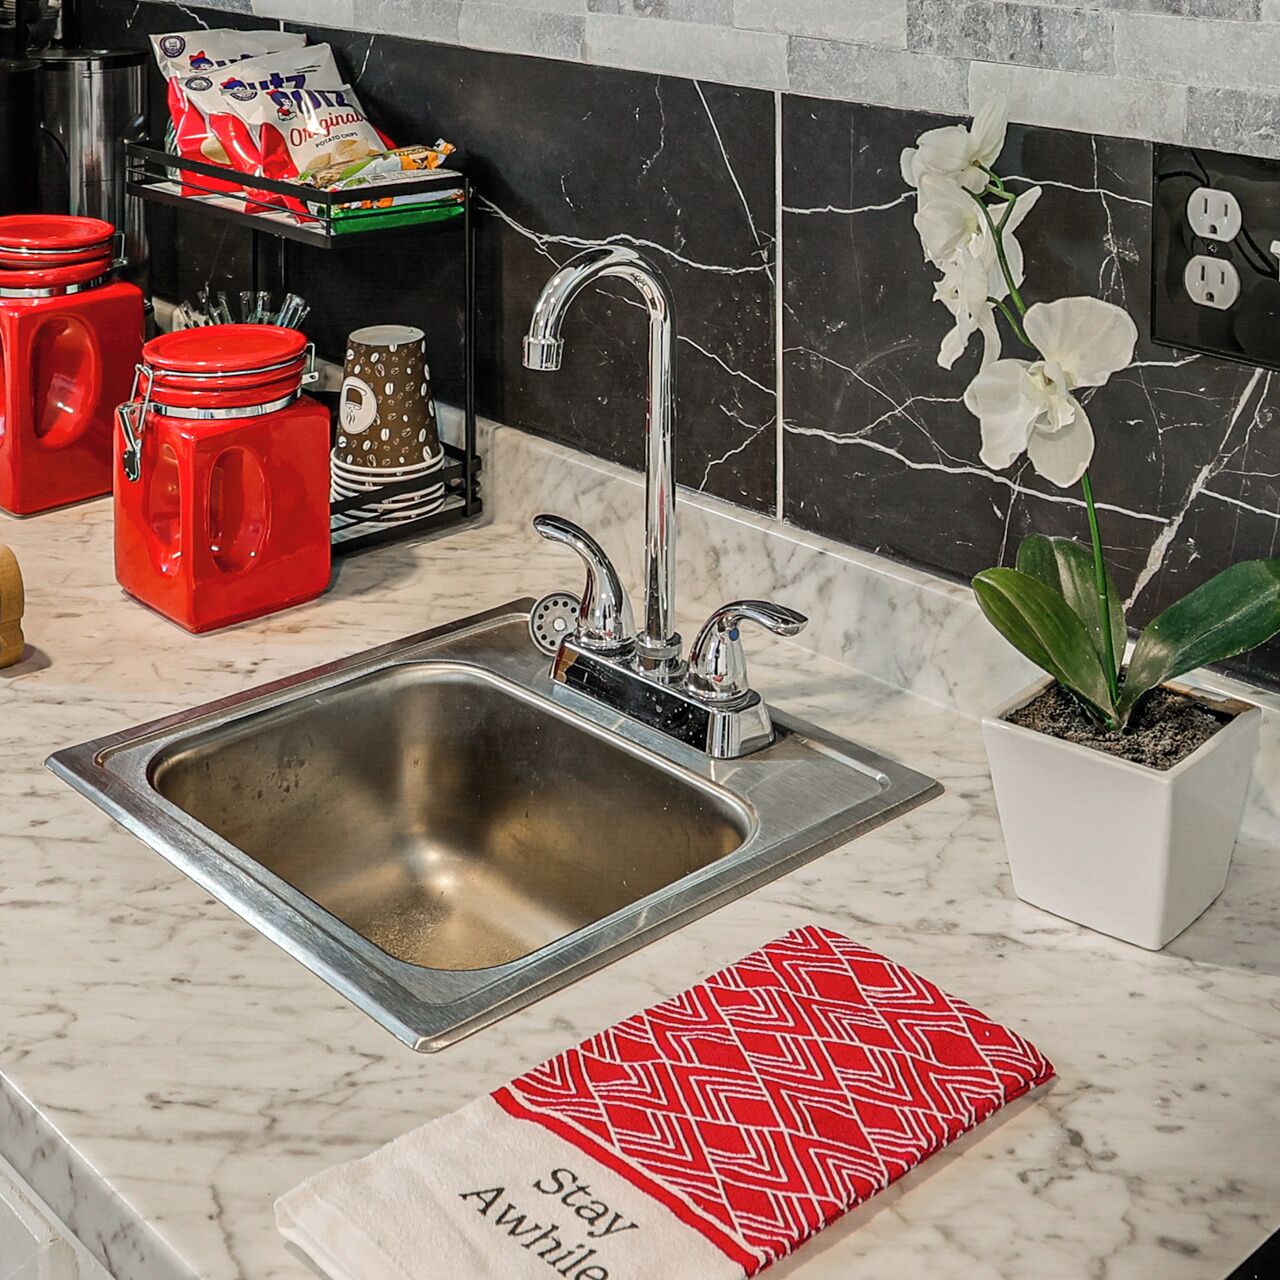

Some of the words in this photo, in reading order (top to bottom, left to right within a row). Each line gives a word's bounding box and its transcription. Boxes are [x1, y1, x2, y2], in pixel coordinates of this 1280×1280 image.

[290, 110, 366, 147] Orginal
[315, 134, 341, 148] POTATO
[341, 131, 359, 140] CHIPS
[532, 1167, 640, 1239] Stay
